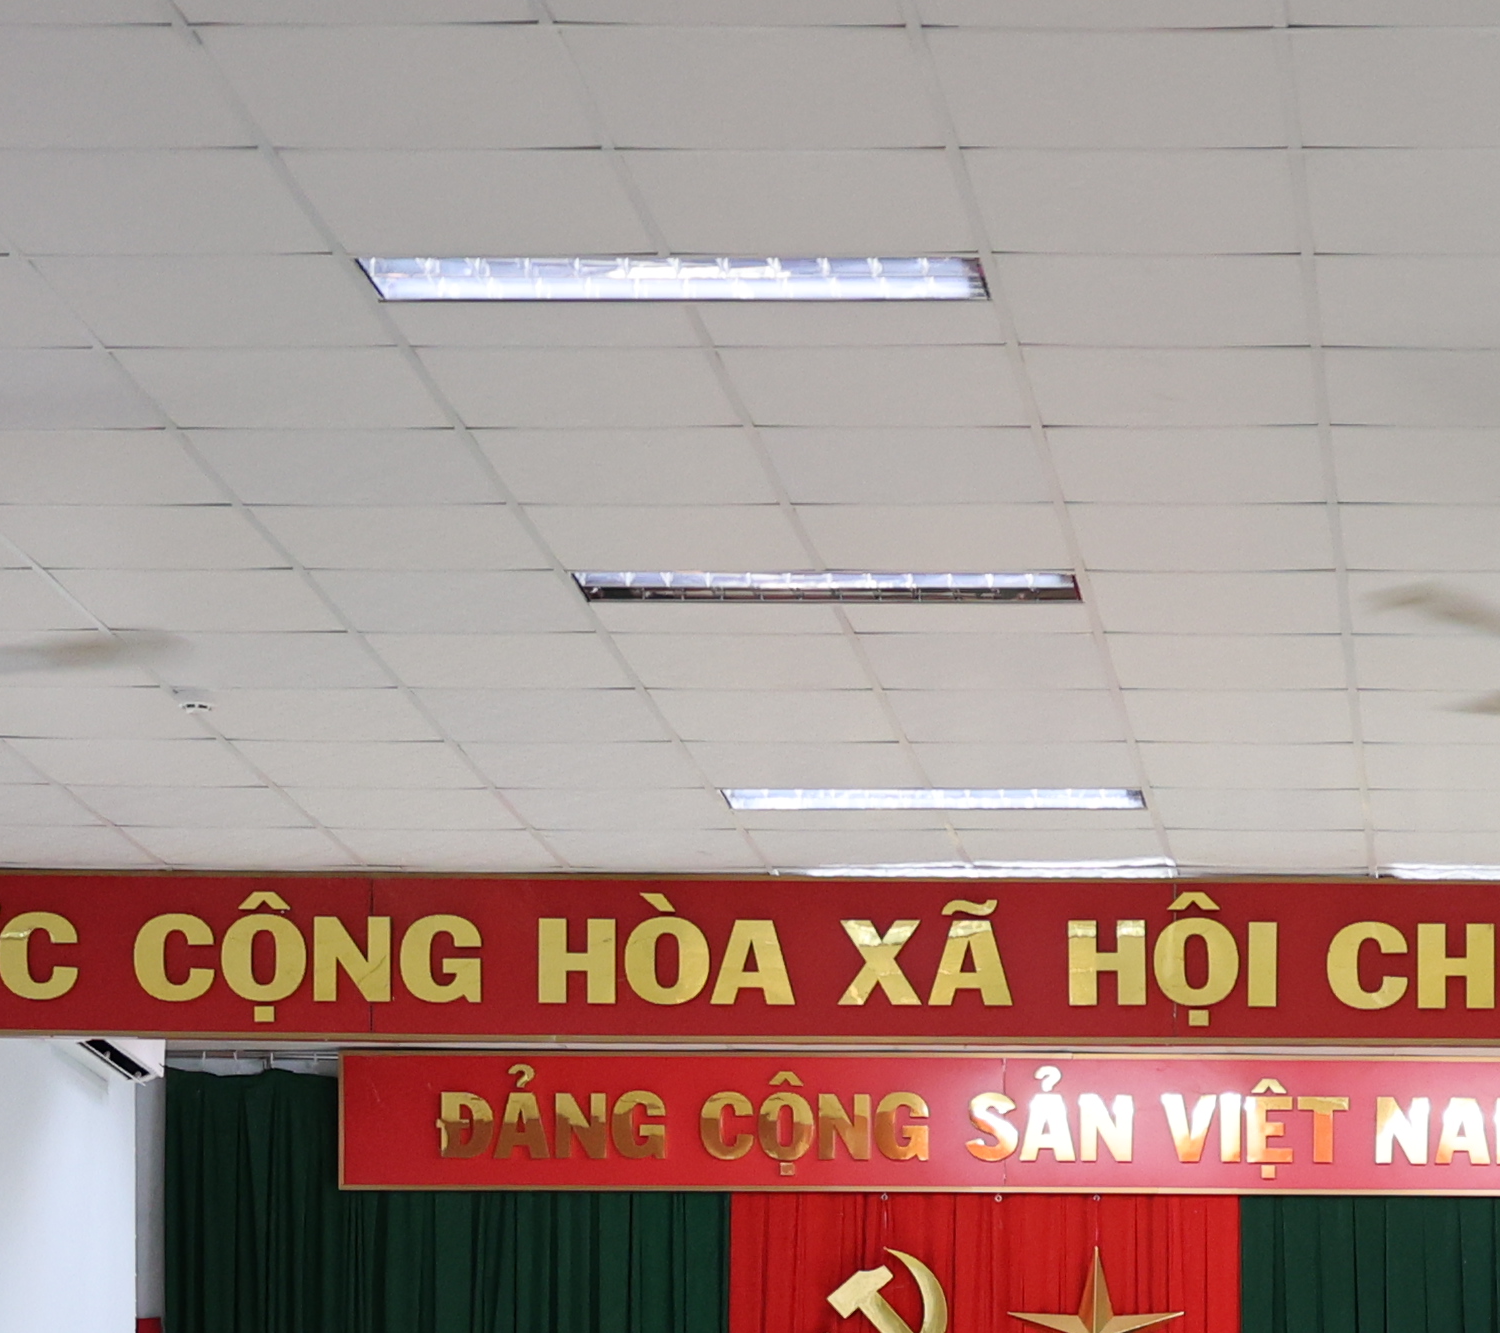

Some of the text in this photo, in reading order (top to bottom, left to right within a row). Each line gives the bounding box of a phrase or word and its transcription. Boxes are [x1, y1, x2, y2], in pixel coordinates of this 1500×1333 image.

[134, 892, 481, 1022] CỘNG
[539, 893, 795, 1005] HÒA
[838, 900, 1012, 1005] XÃ
[1068, 892, 1277, 1025] HỘI
[437, 1064, 665, 1158] ĐẢNG
[702, 1072, 931, 1175] CỘNG
[968, 1066, 1134, 1161] SẢN
[1159, 1079, 1348, 1177] VIỆT
